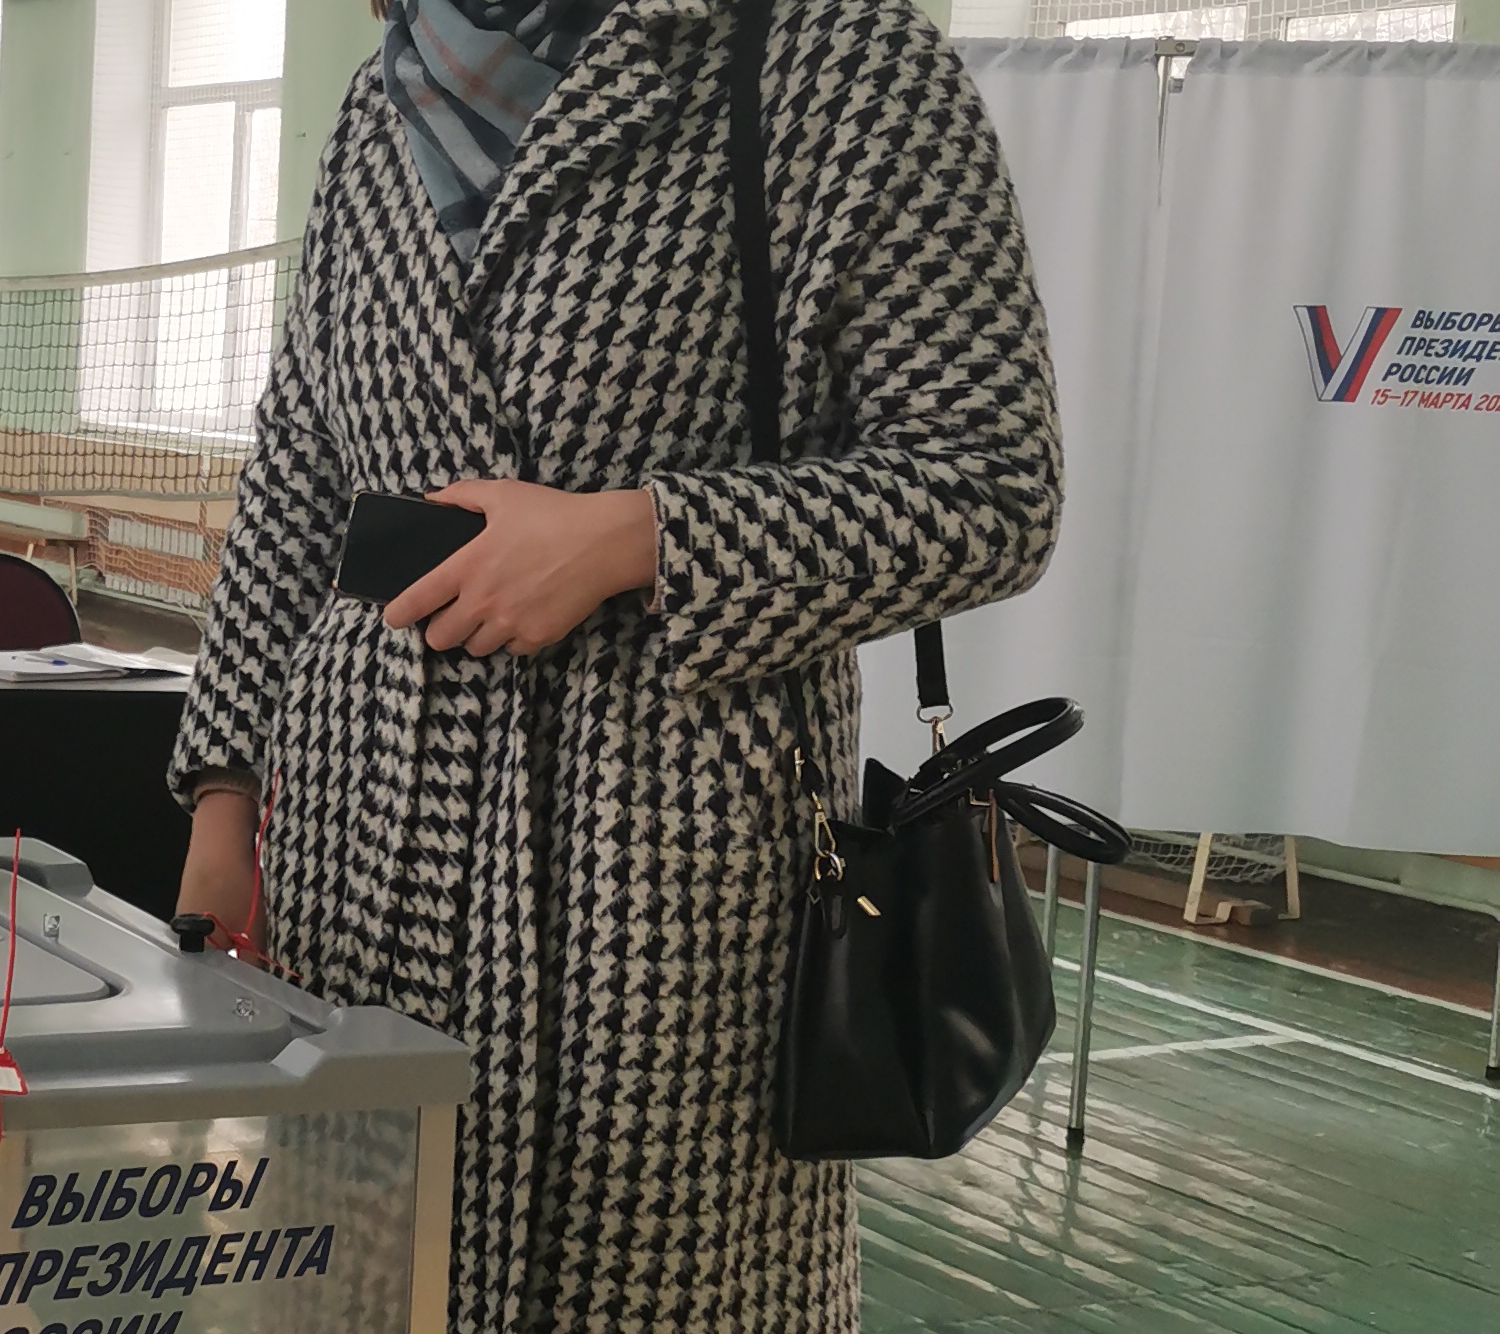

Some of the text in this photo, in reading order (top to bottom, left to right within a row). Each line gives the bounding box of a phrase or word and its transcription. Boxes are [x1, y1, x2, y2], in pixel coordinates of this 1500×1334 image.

[1396, 335, 1500, 363] ПРЕЗИДЕ
[1382, 362, 1476, 386] РОССИИ
[1417, 391, 1473, 410] МАРТА
[11, 1157, 270, 1229] ВЫБОРЫ
